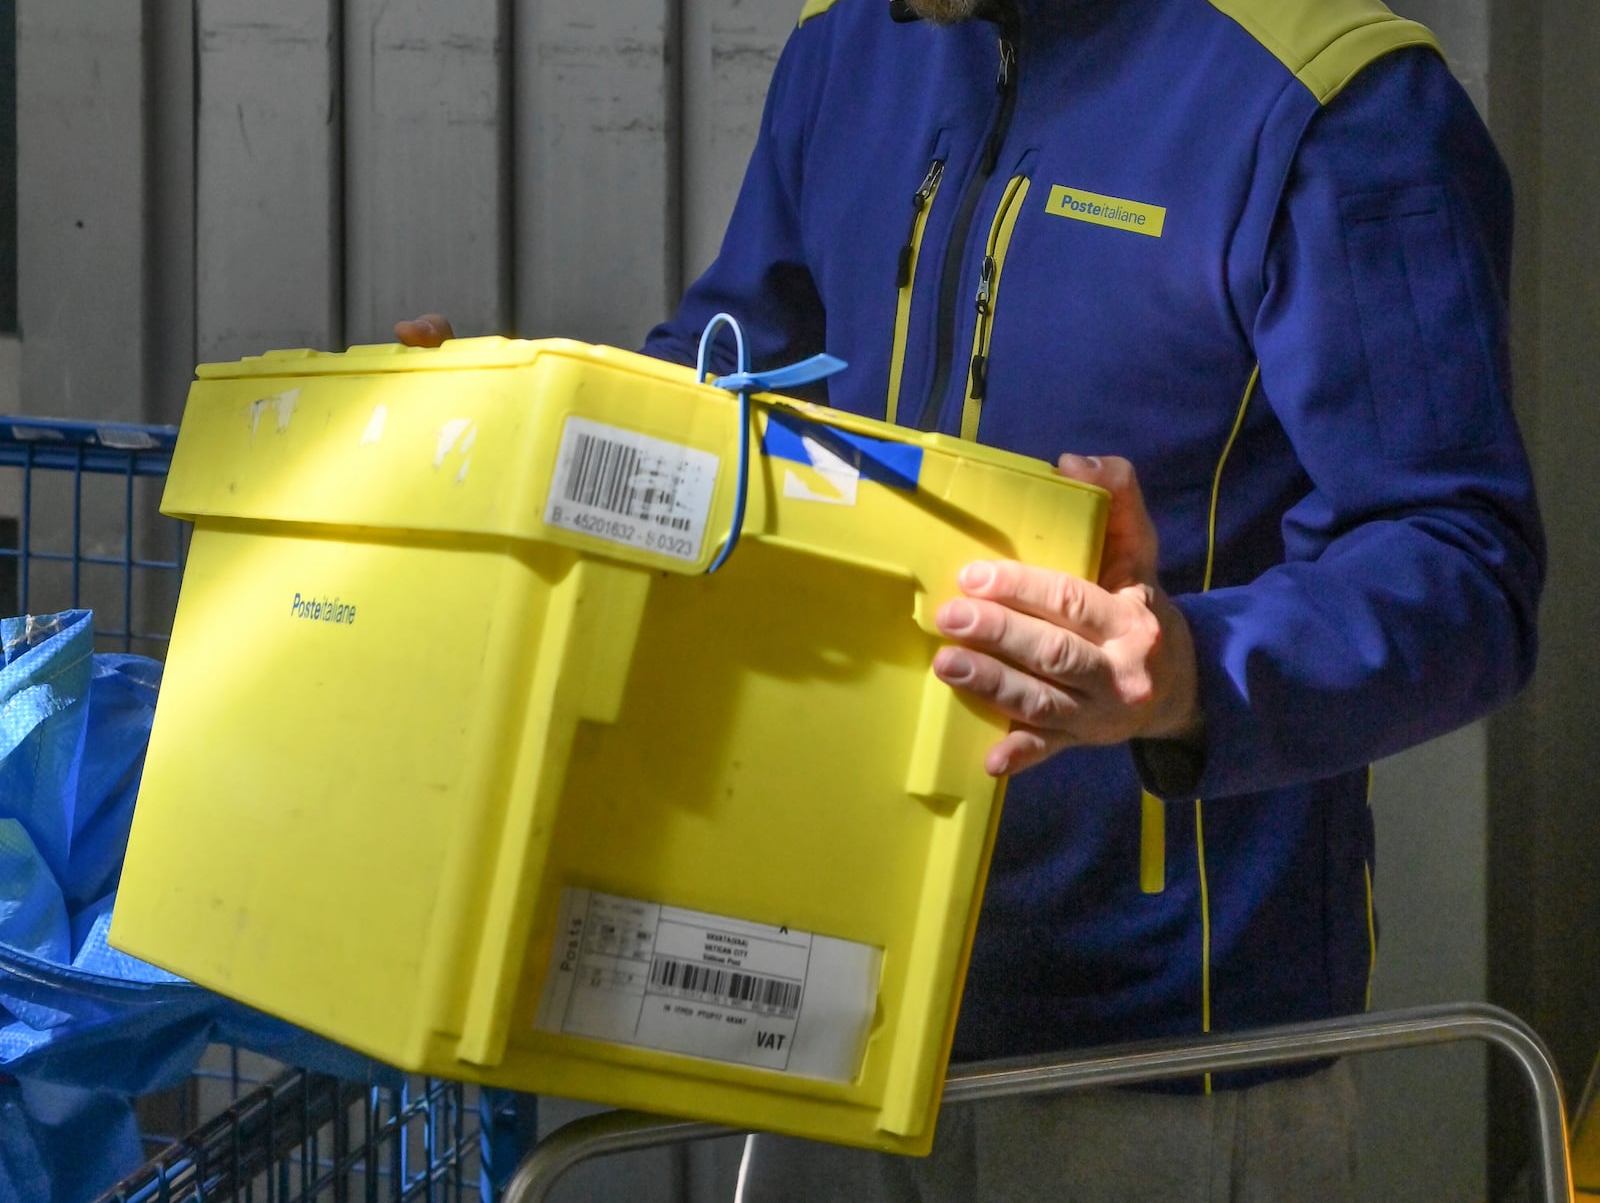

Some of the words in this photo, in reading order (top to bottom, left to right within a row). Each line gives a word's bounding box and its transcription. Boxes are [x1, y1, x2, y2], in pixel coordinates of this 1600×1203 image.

[1061, 194, 1146, 225] Posteitaliane
[552, 505, 563, 523] B
[291, 593, 357, 625] Posteitaliane
[757, 1030, 786, 1051] VAT
